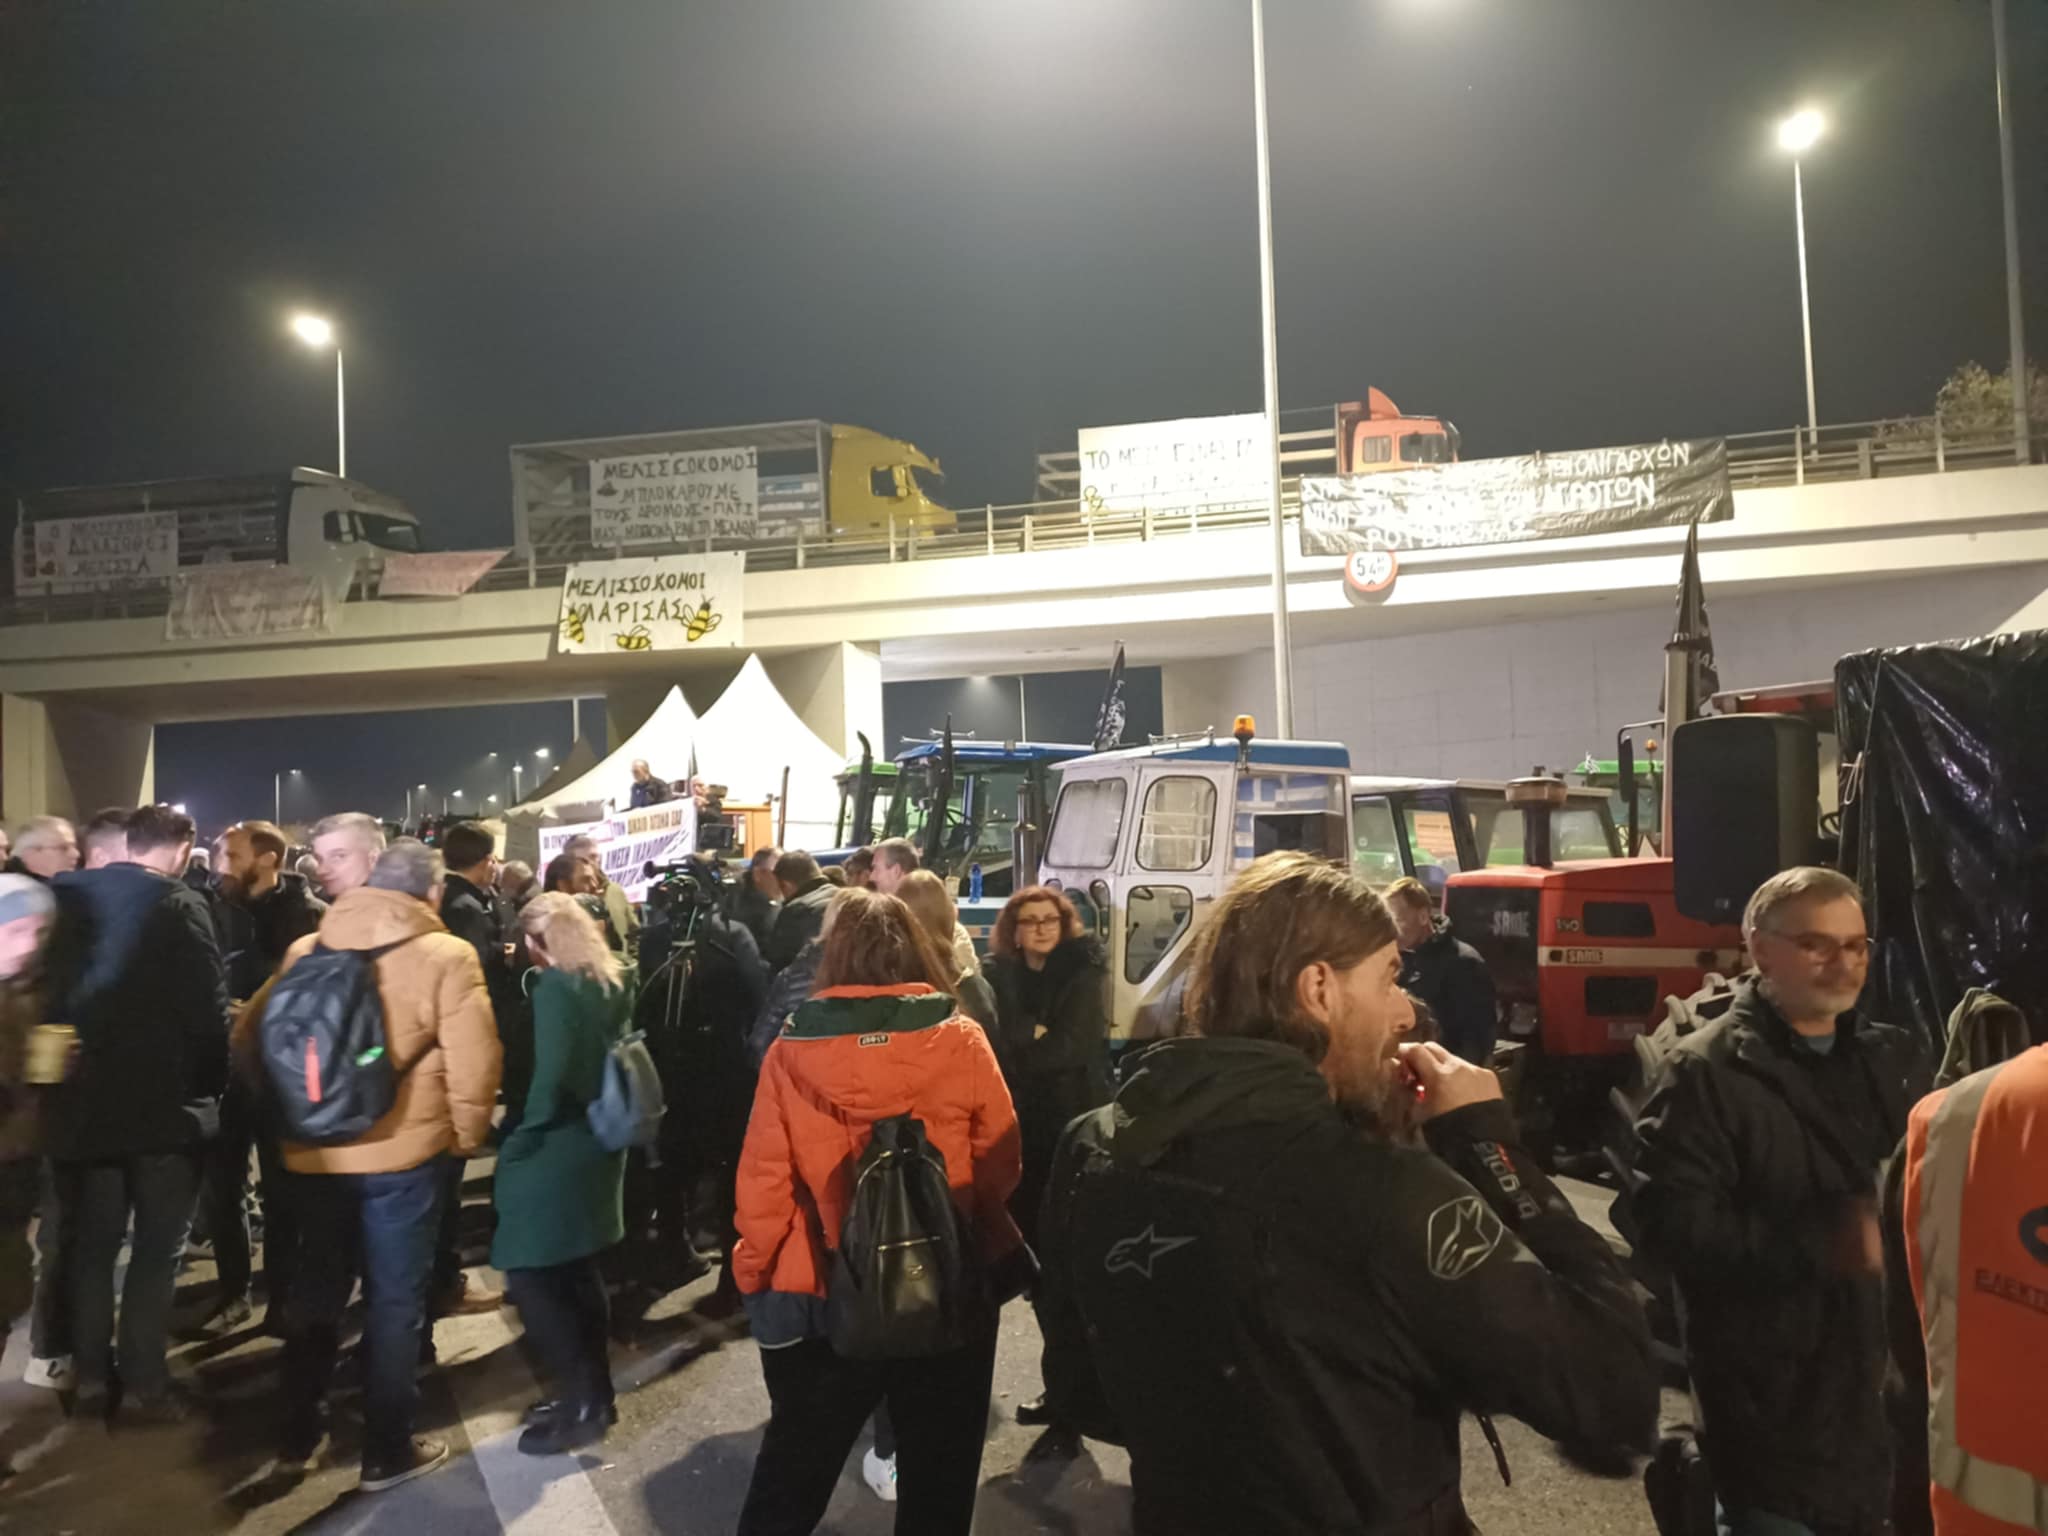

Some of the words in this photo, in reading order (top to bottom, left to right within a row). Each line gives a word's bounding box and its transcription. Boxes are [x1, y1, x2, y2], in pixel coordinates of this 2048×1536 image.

[566, 571, 706, 600] ΜΕΛΙΣΣΟΚΟΜΟΙ
[582, 598, 684, 625] ΛΑΡΙΣΑΣ
[1492, 910, 1530, 937] SAME
